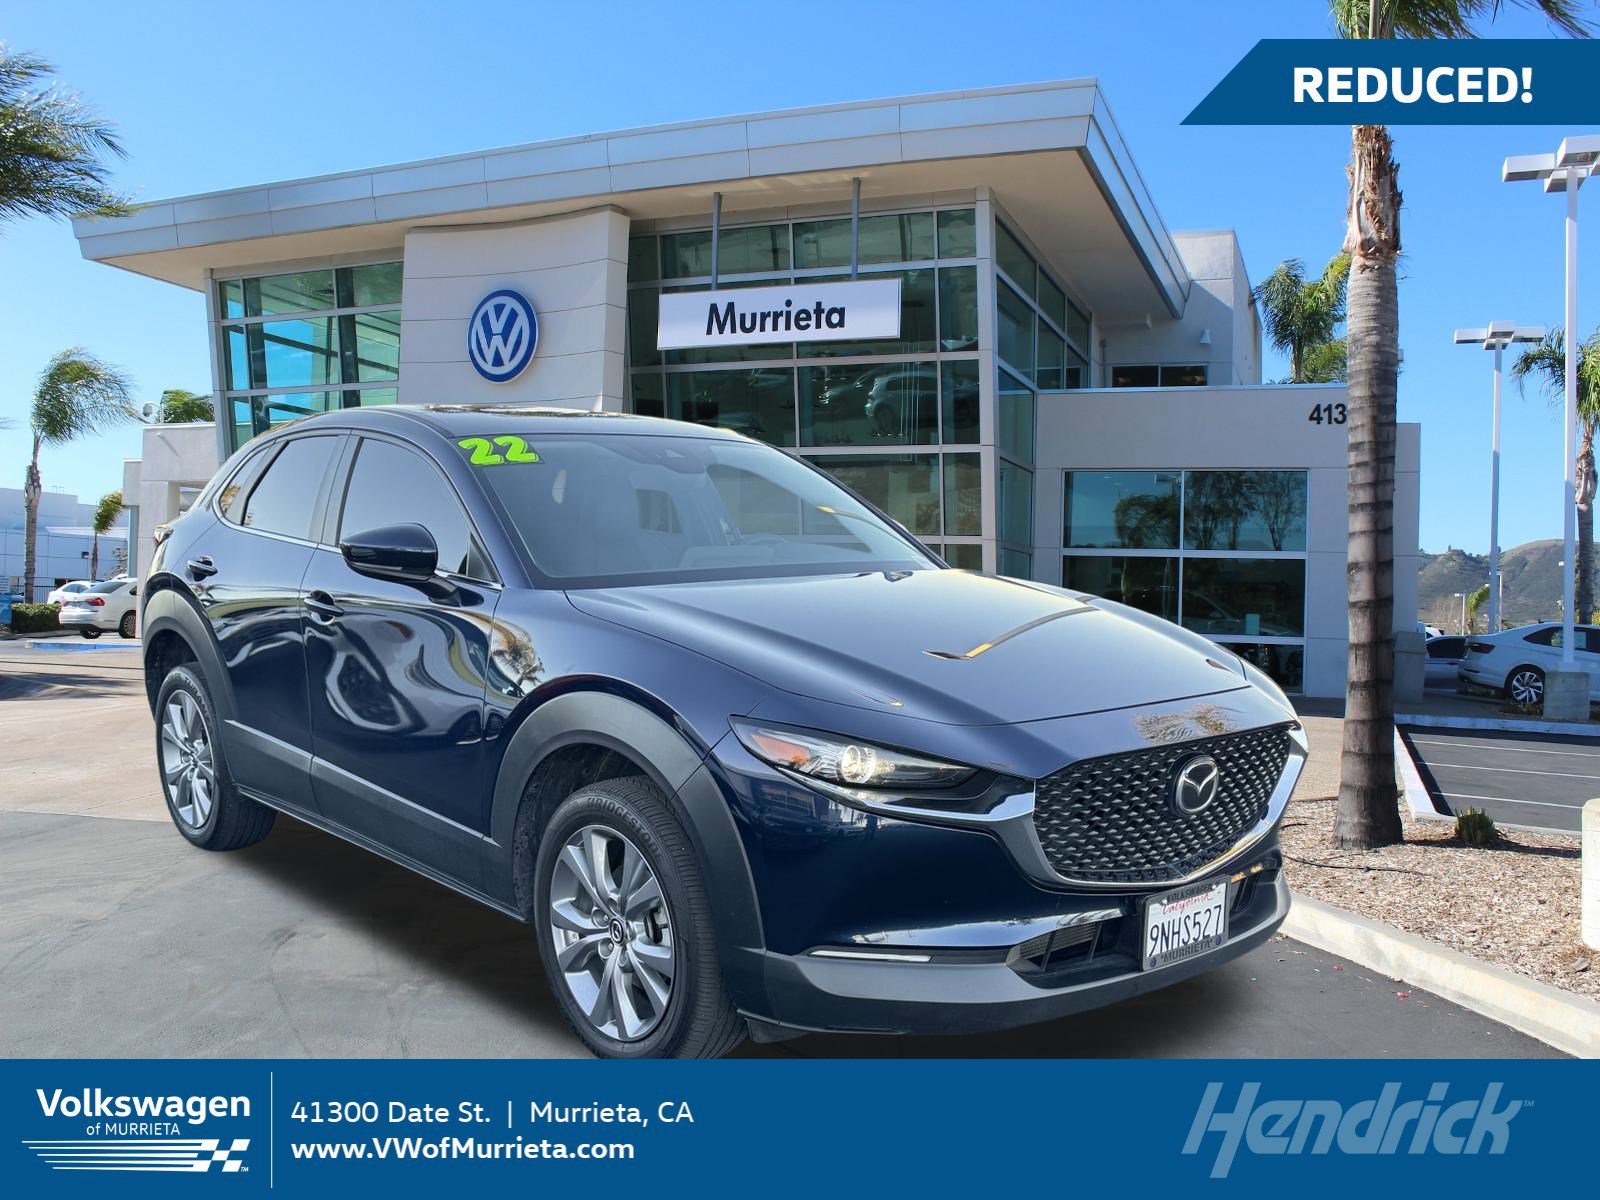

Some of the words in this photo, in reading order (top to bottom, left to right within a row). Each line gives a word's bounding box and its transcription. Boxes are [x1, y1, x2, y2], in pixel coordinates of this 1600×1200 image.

[706, 299, 846, 336] Murrieta
[458, 435, 540, 466] 22
[587, 797, 665, 863] BRIDGESTONE
[1148, 904, 1222, 957] 9NHS527
